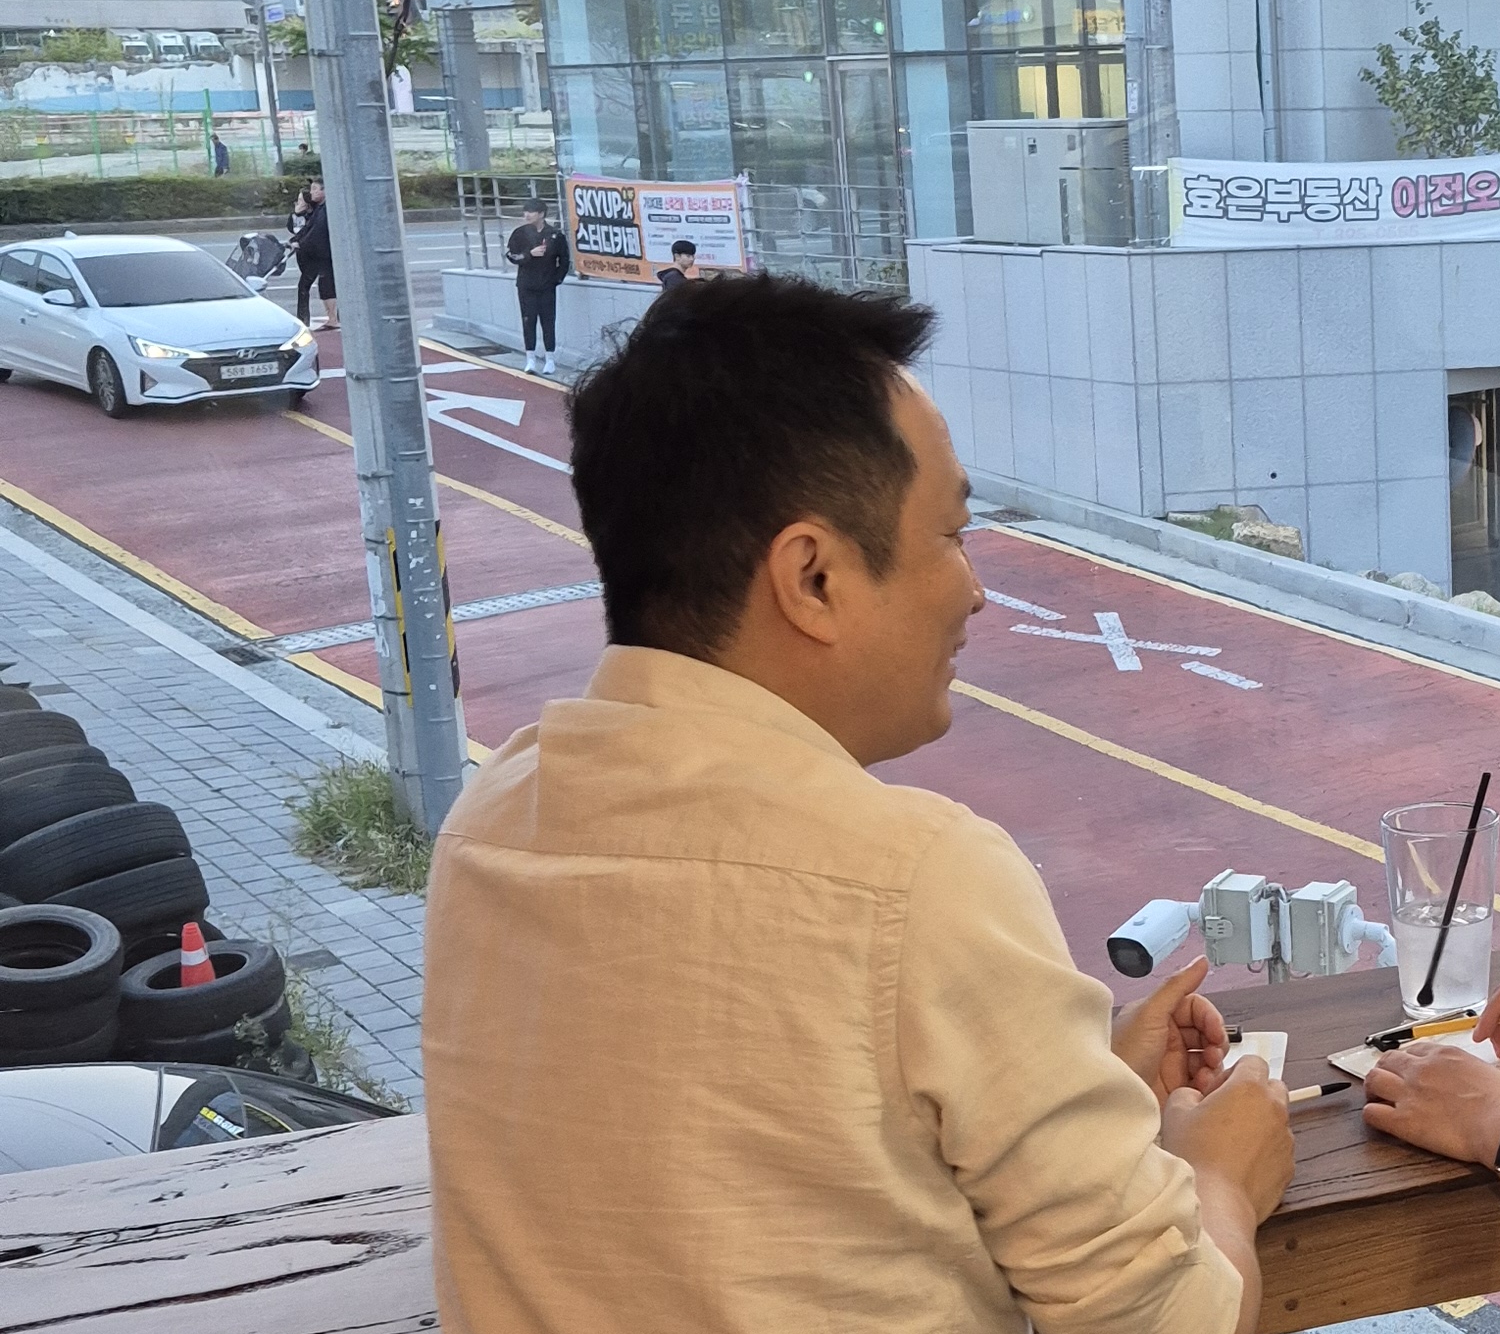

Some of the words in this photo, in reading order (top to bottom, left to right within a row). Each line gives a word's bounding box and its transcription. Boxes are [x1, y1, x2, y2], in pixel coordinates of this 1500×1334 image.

[574, 187, 622, 219] SKYUP
[1183, 174, 1382, 223] 효은부동산
[577, 222, 642, 258] 스터디카페
